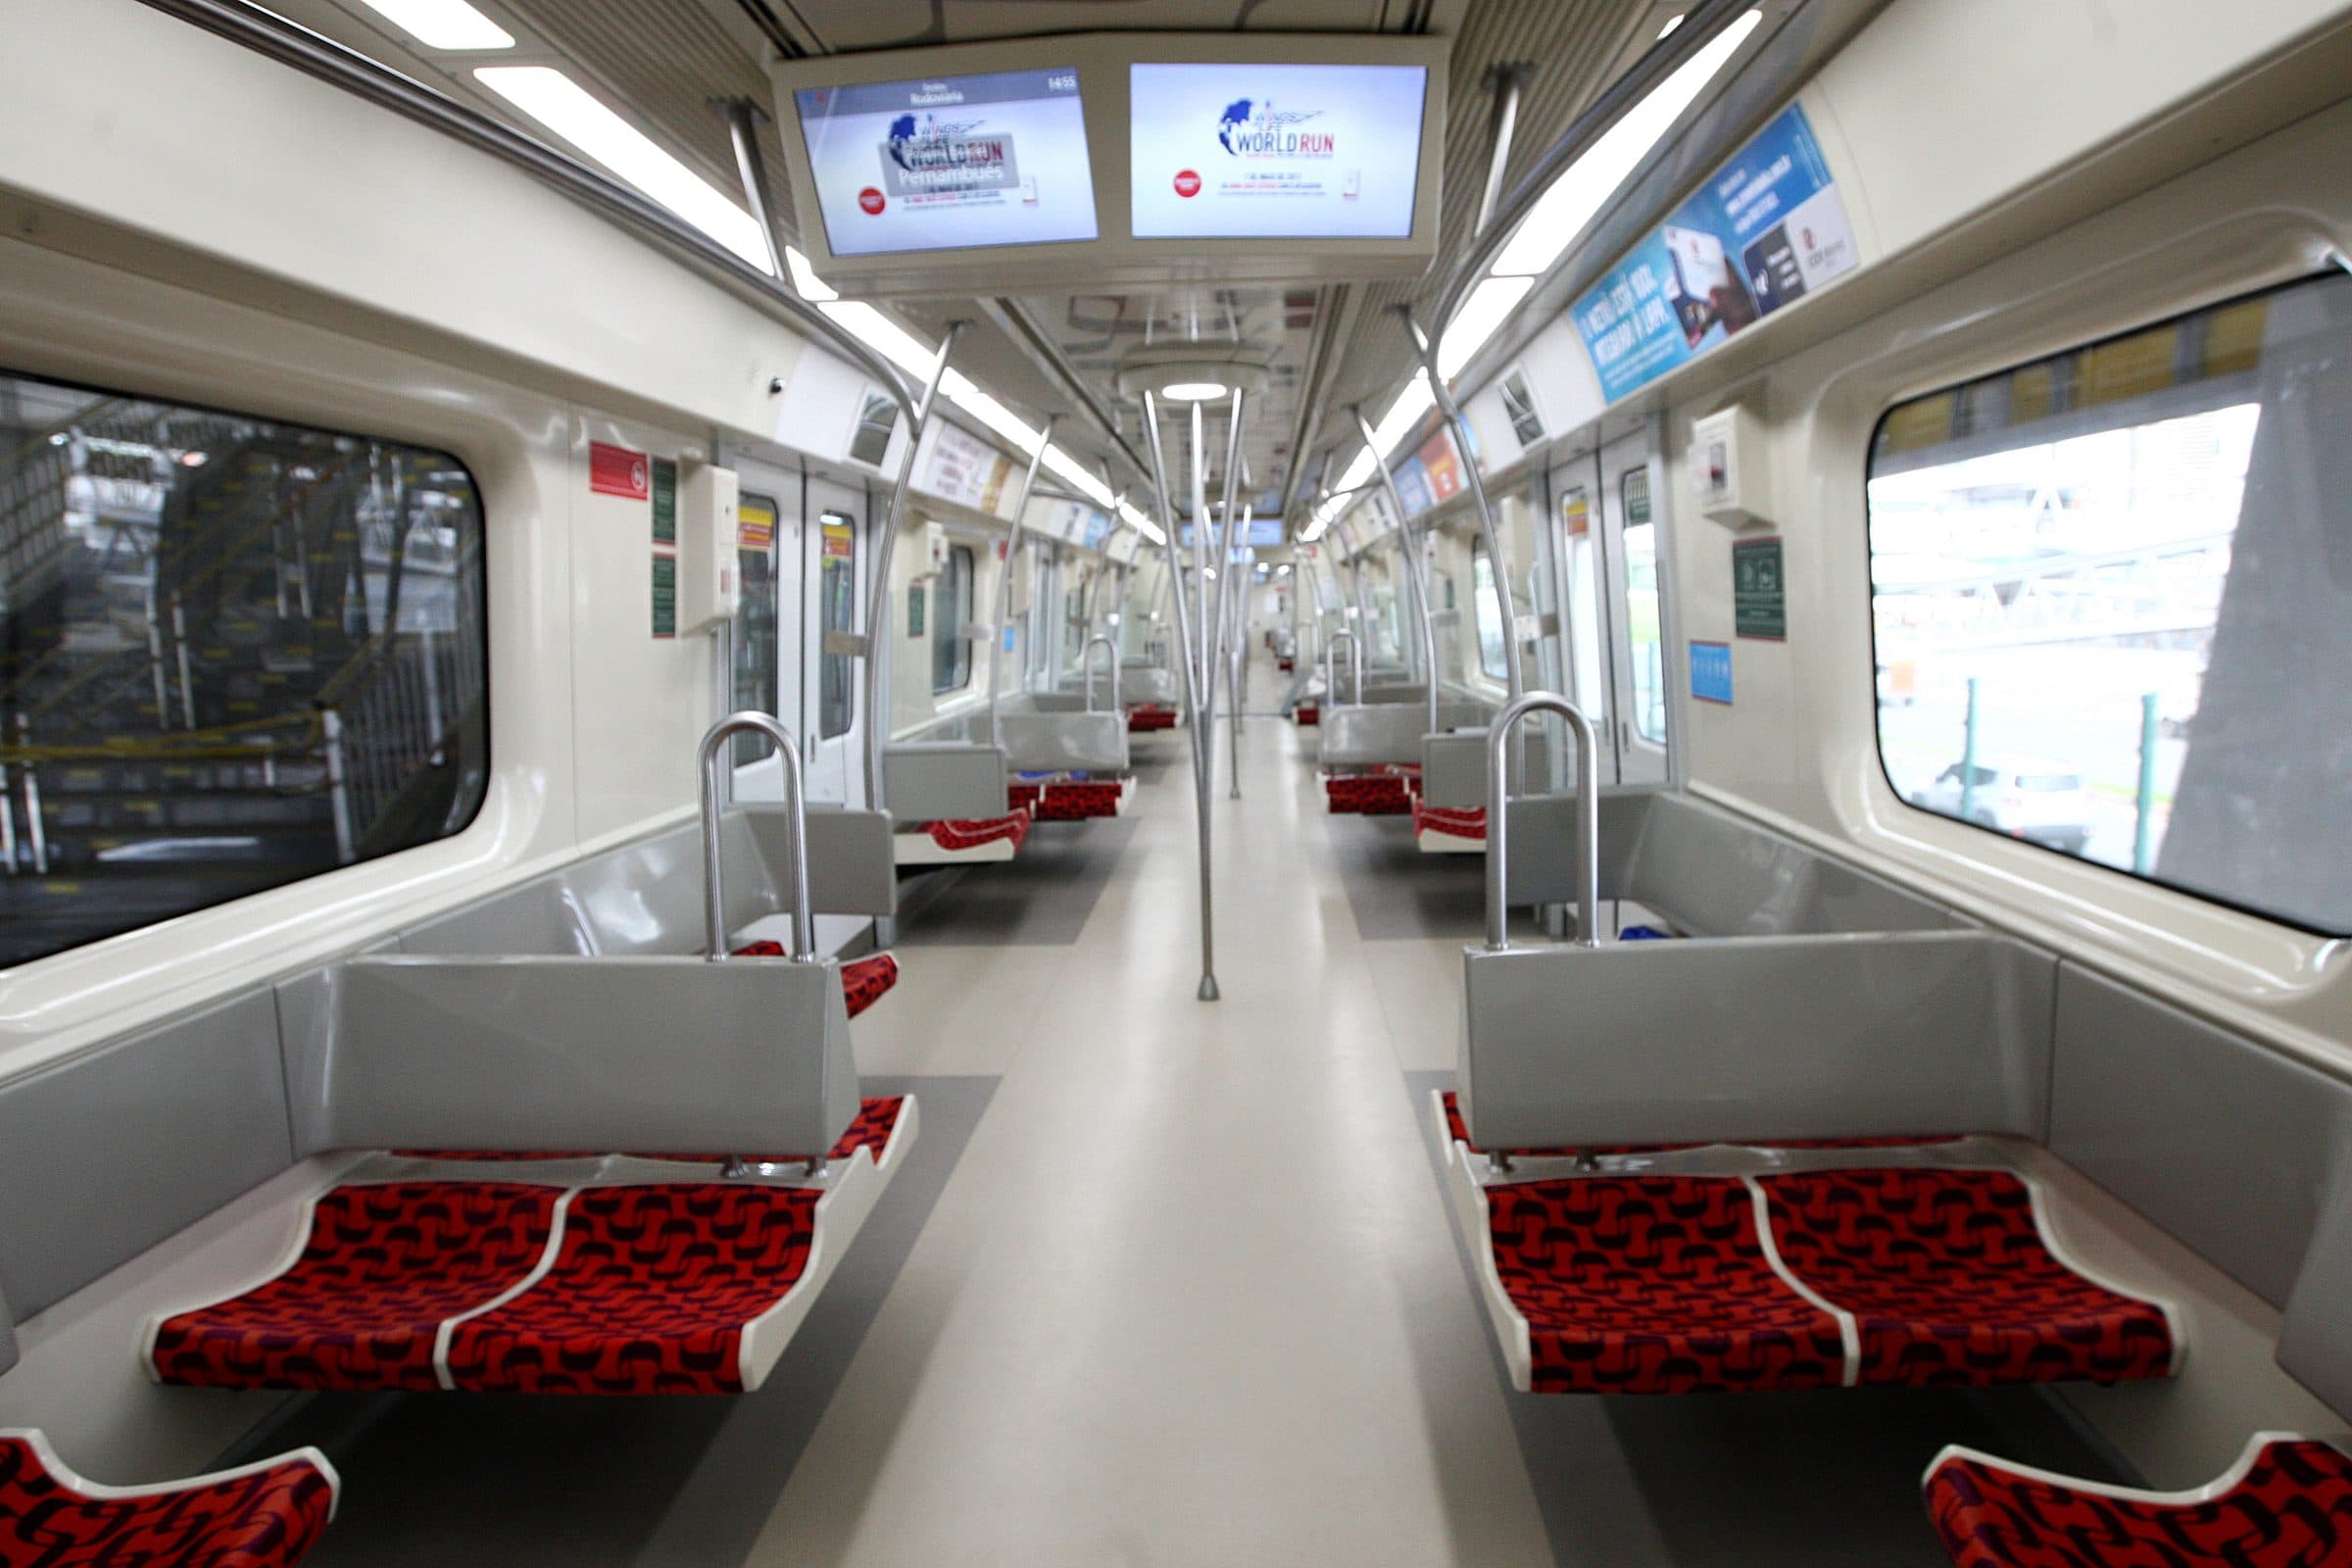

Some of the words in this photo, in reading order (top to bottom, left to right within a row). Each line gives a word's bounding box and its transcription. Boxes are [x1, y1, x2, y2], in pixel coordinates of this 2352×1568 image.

[1238, 132, 1297, 152] WORLD
[1299, 132, 1335, 152] RUN
[909, 143, 967, 167] WORLD
[967, 141, 1003, 163] RUN
[899, 165, 1004, 186] Pernambués
